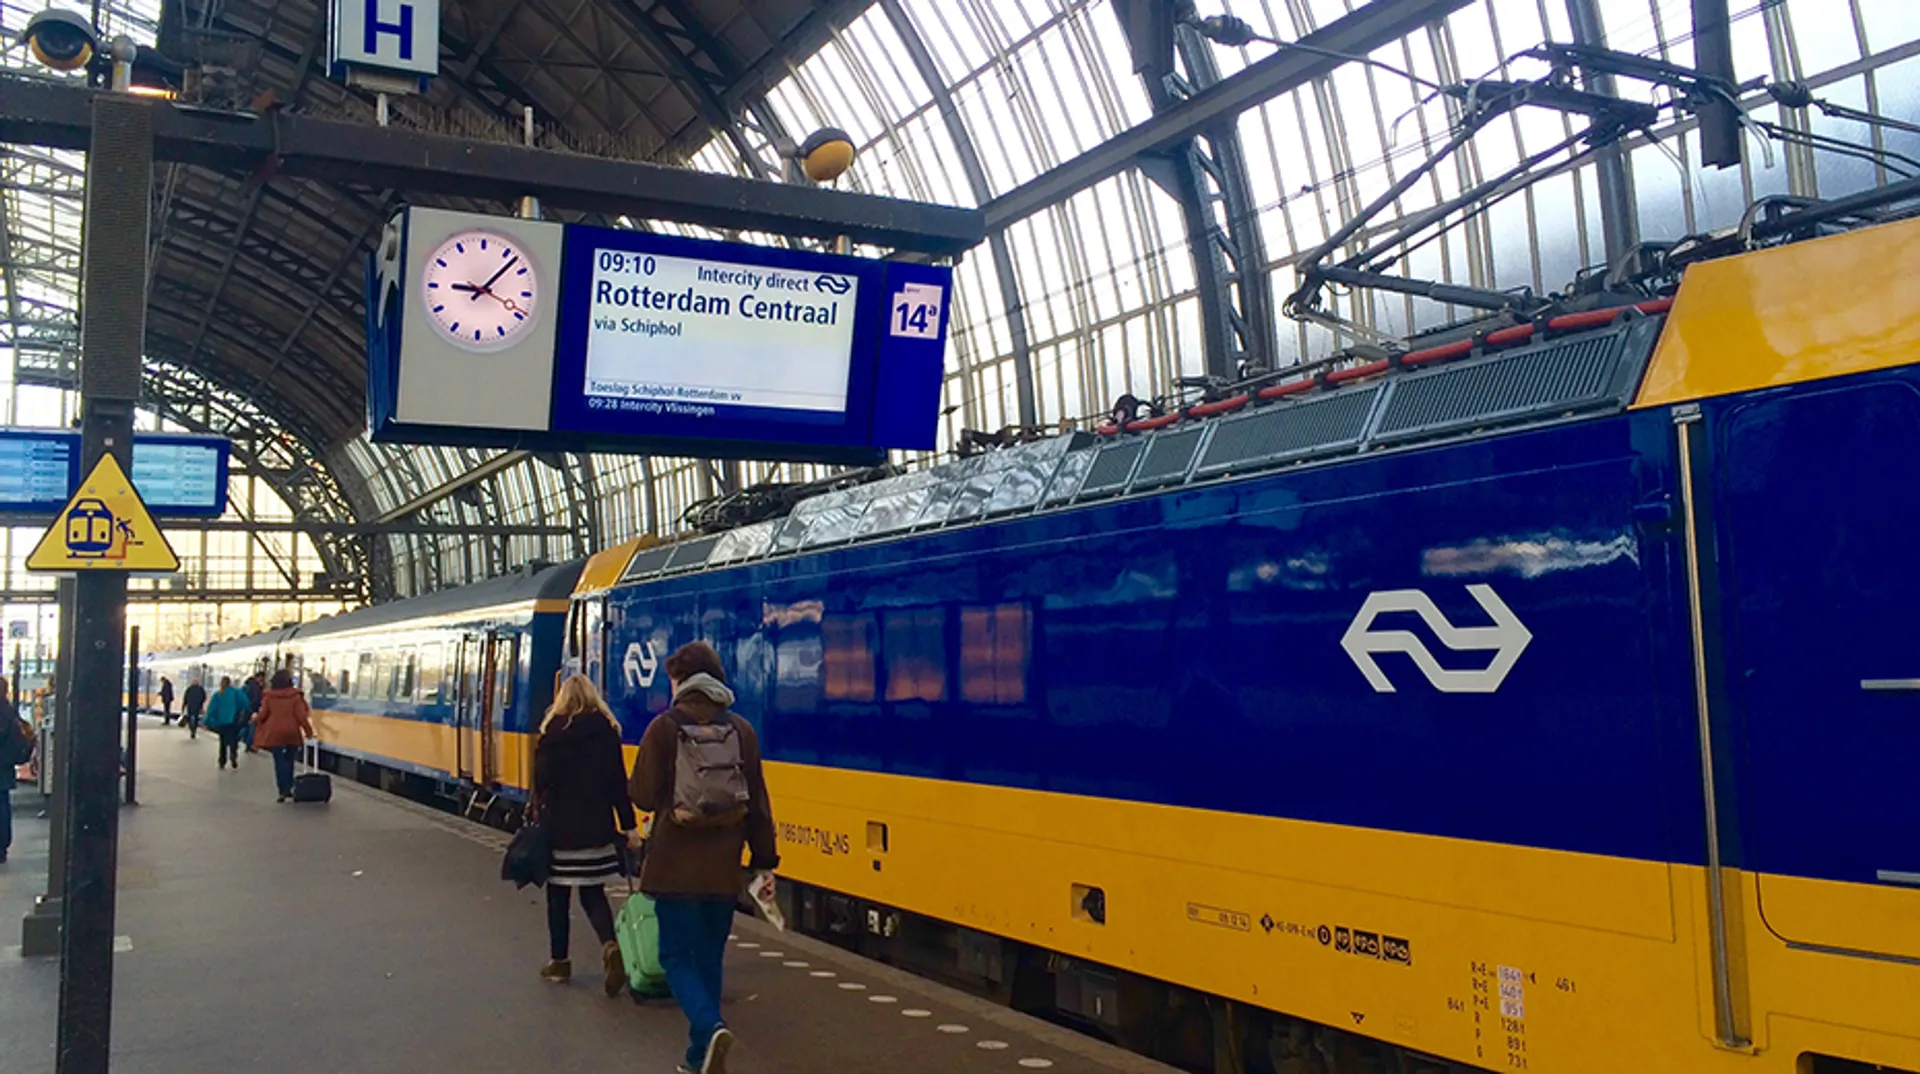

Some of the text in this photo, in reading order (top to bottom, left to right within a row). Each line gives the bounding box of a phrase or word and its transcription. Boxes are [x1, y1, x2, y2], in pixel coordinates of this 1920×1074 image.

[364, 0, 413, 60] H
[599, 250, 656, 276] 09:10
[697, 266, 808, 292] Intercity direct
[596, 280, 836, 325] Rotterdam Centraal
[594, 316, 682, 337] via Schiphol
[620, 400, 663, 414] Intercity
[665, 402, 715, 418] Vlissingen
